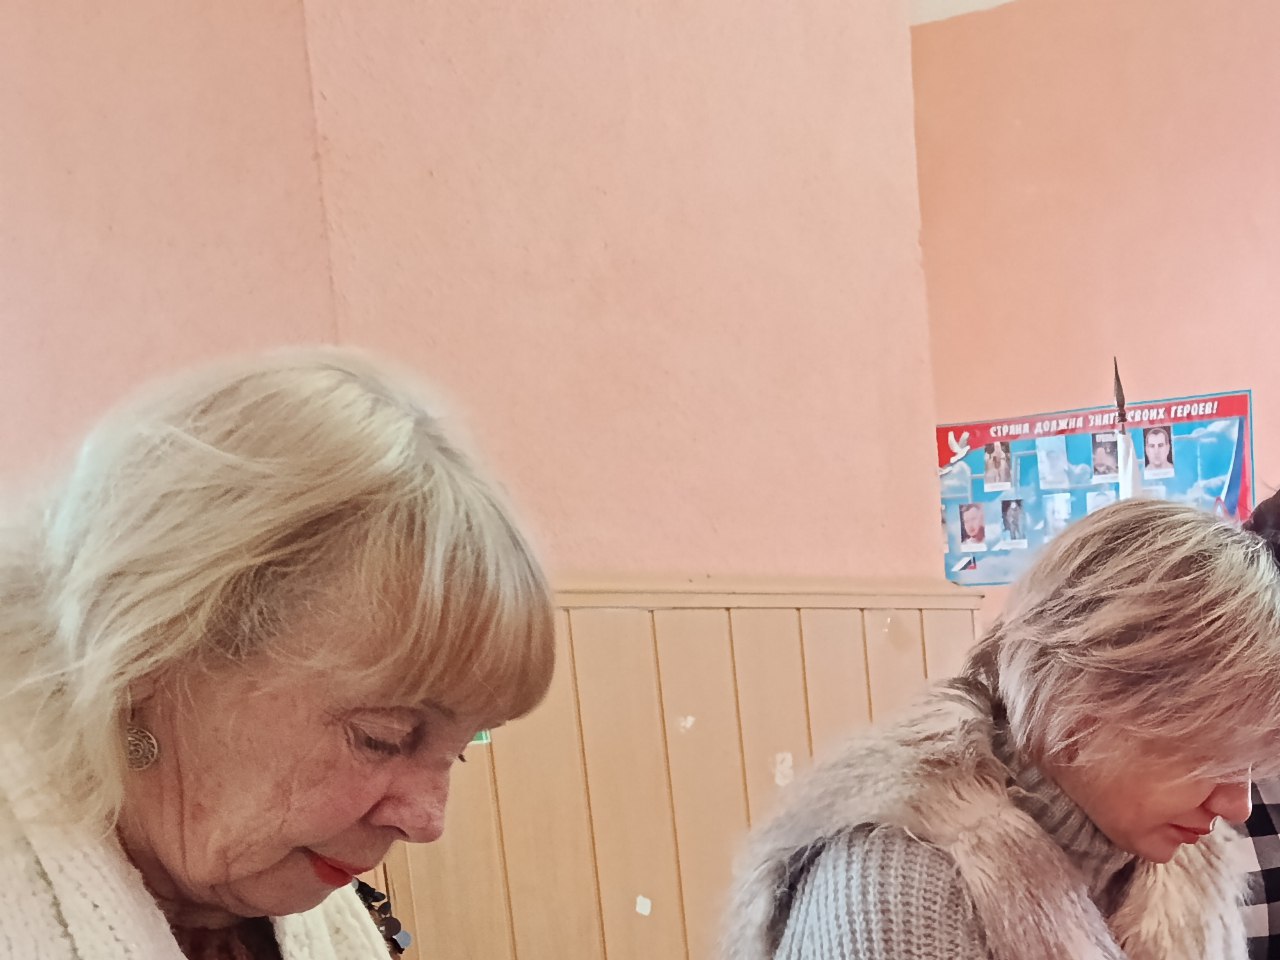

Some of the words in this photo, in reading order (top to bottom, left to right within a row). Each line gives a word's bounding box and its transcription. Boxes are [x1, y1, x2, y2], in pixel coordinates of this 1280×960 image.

[989, 423, 1030, 437] СТРАНА
[1034, 417, 1083, 434] ДОЛЖНА
[1126, 408, 1166, 422] СВОИХ
[1170, 401, 1218, 418] ГЕРОЕВ!
